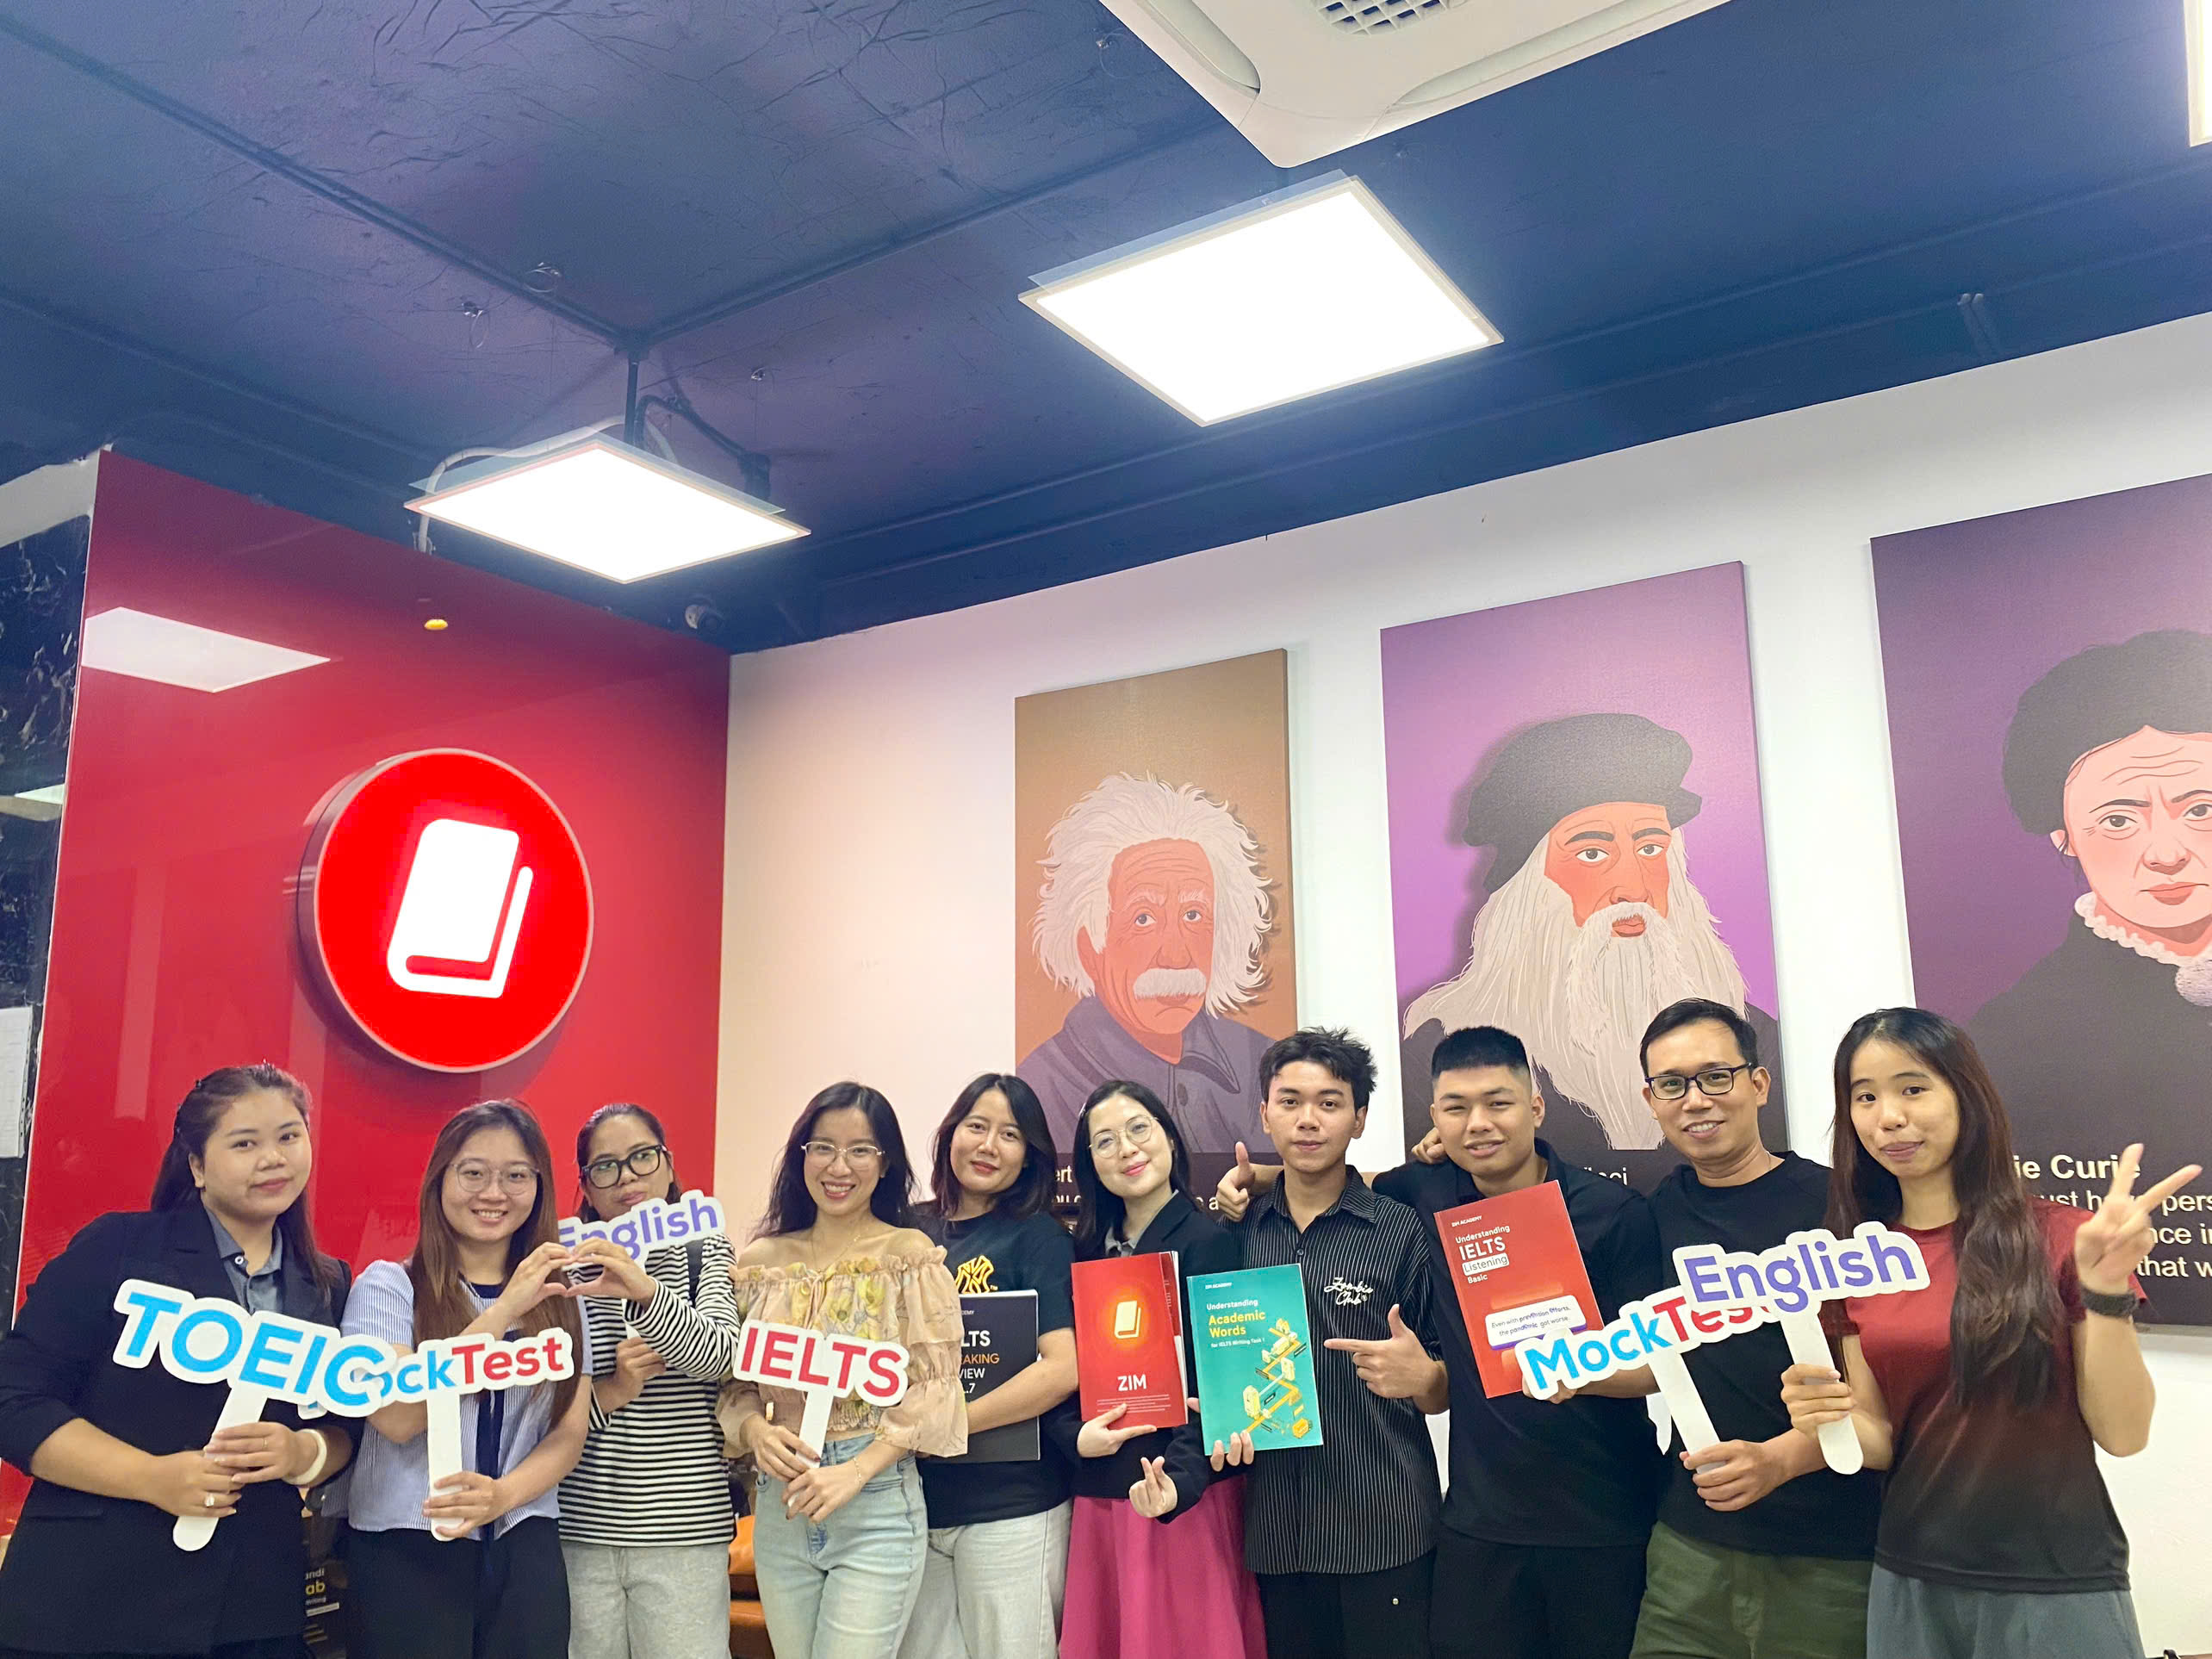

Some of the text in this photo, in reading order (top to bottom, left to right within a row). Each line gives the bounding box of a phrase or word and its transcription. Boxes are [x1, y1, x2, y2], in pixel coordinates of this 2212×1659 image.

[1455, 1225, 1511, 1244] Understanding
[1459, 1236, 1507, 1260] IELTS
[1464, 1255, 1508, 1273] Listening
[1467, 1273, 1488, 1284] Basic
[1684, 1235, 1917, 1314] English
[1206, 1299, 1258, 1310] Understanding
[1209, 1309, 1266, 1326] Academic
[1209, 1325, 1246, 1339] Words
[126, 1291, 386, 1407] TOEIC
[741, 1327, 904, 1398] IELTS
[963, 1352, 1000, 1365] AKING
[1117, 1374, 1147, 1392] ZIM
